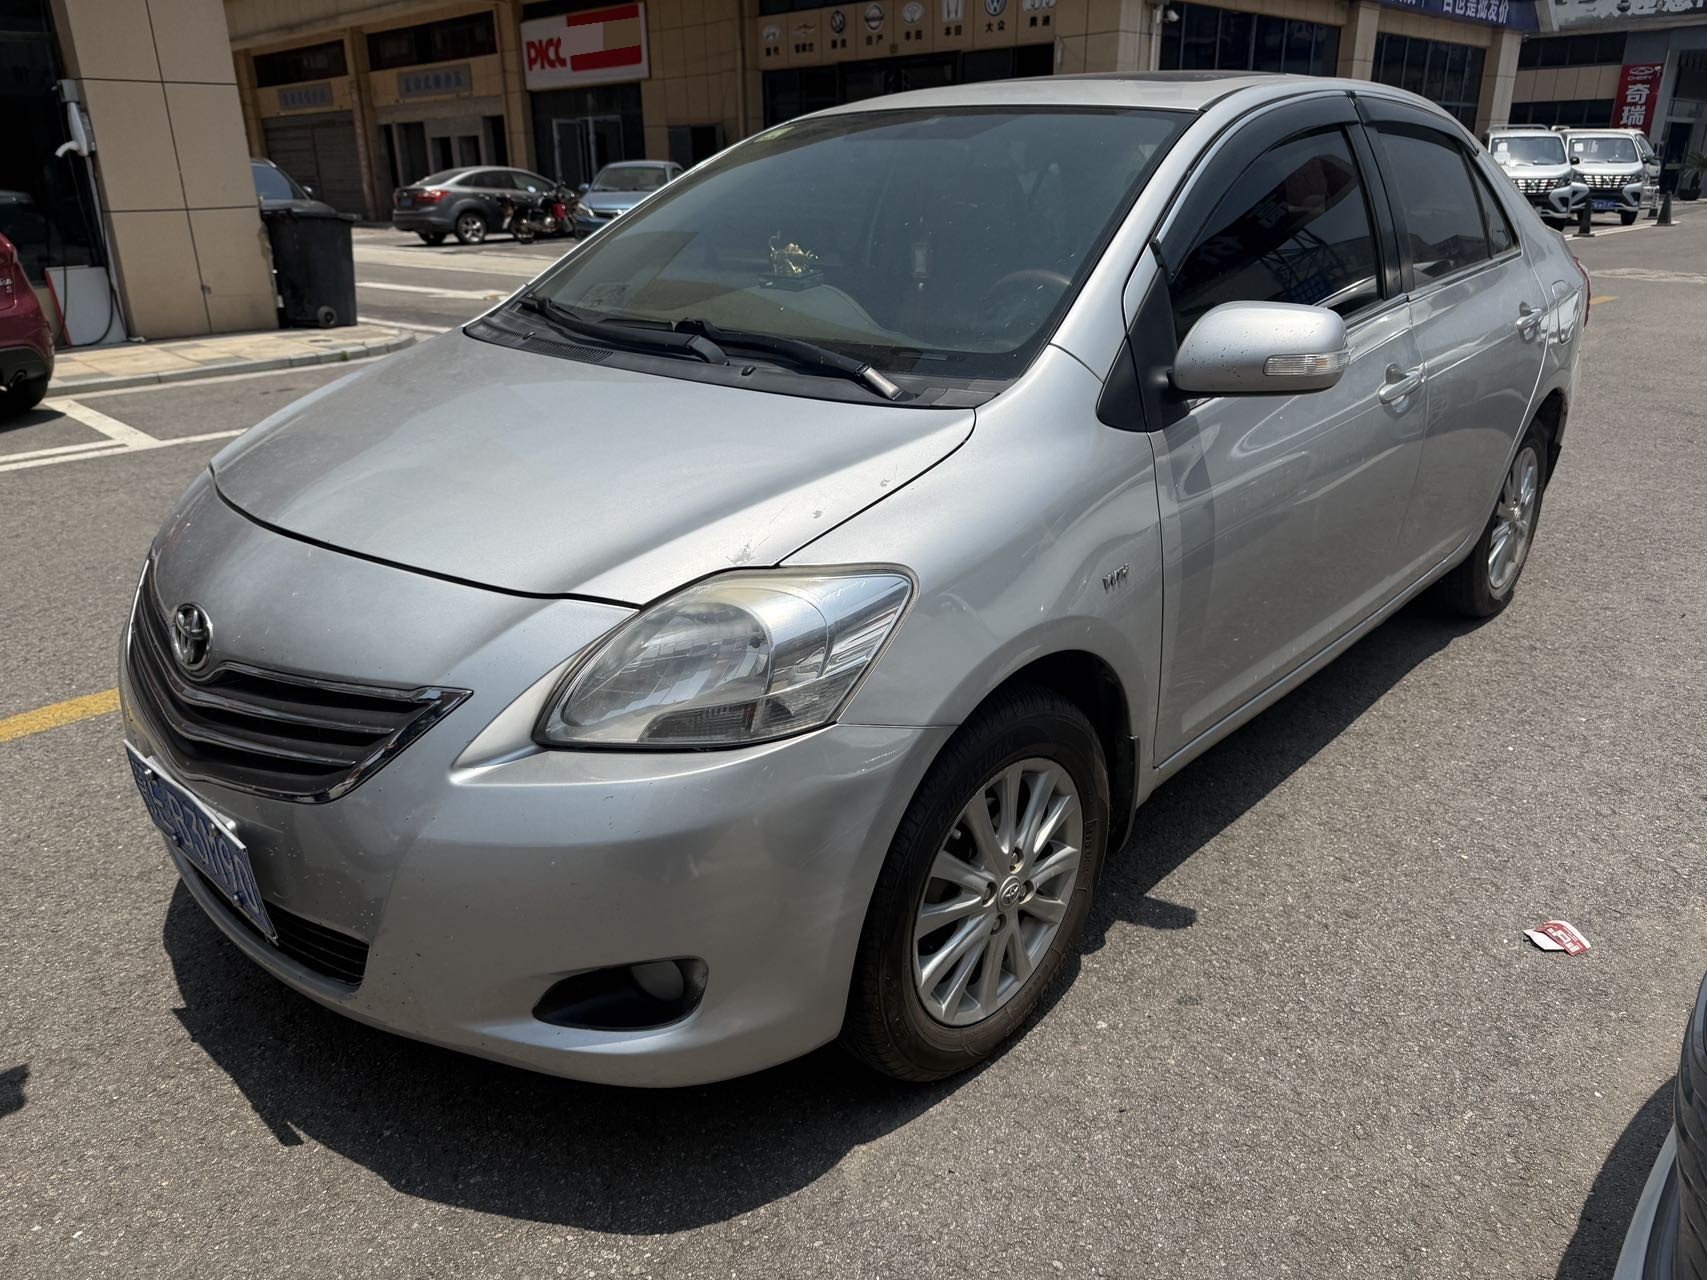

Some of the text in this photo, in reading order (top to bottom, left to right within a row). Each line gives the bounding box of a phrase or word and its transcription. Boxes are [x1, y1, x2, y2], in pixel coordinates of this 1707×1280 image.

[985, 20, 1005, 33] 大众
[526, 37, 567, 71] PICC
[1619, 83, 1651, 129] 奇瑞
